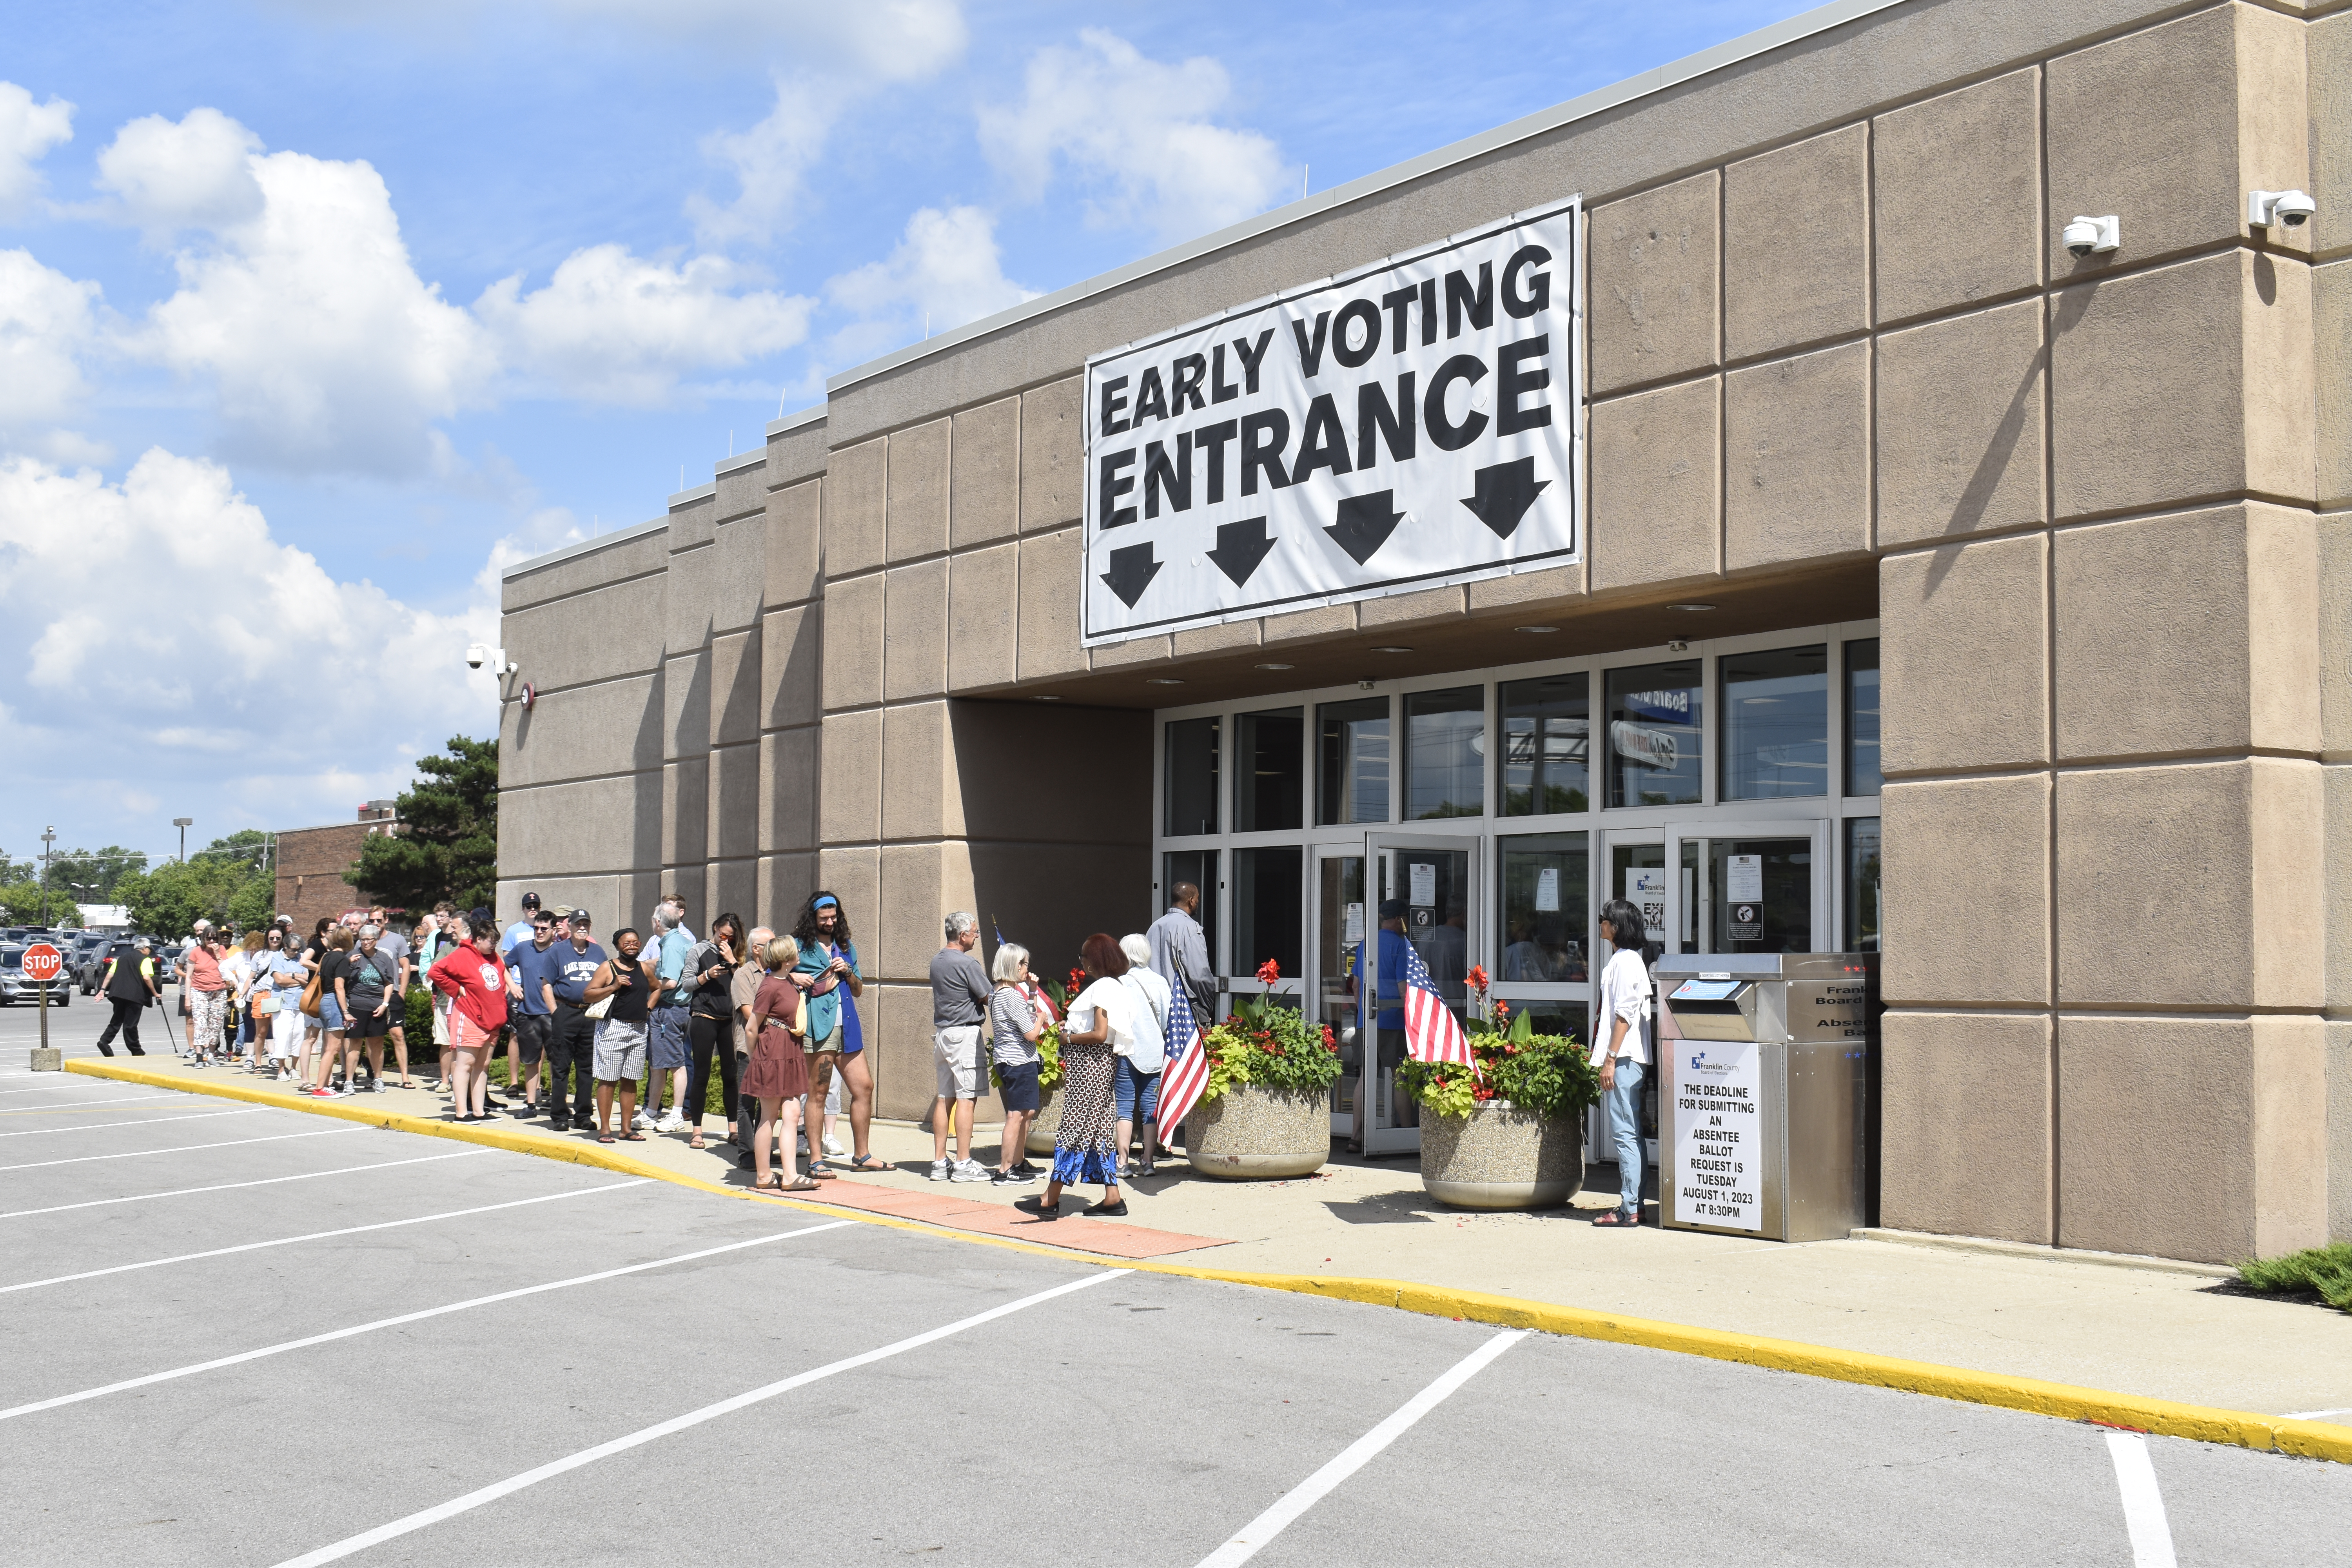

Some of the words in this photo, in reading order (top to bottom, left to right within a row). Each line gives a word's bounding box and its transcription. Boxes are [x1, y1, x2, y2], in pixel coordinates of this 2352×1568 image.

[1101, 327, 1275, 437] EARLY
[1291, 244, 1553, 379] VOTING
[1100, 333, 1552, 531] ENTRANCE
[1644, 903, 1664, 915] EXI
[25, 955, 60, 970] STOP
[564, 961, 578, 975] LAKE
[1844, 1028, 1880, 1036] Ball
[1723, 1063, 1740, 1073] County
[1684, 1083, 1701, 1095] THE
[1704, 1085, 1748, 1098] DEADLINE
[1679, 1098, 1696, 1110] FOR
[1698, 1099, 1754, 1114] SUBMITTING
[1709, 1115, 1722, 1126] AN
[1693, 1129, 1740, 1143] ABSENTEE
[1699, 1144, 1733, 1157] BALLOT
[1690, 1158, 1731, 1172] REQUEST
[1734, 1162, 1743, 1173] IS
[1696, 1173, 1737, 1188] TUESDAY
[1682, 1187, 1719, 1201] AUGUST
[1721, 1191, 1729, 1204] 1,
[1731, 1192, 1753, 1204] 2023
[1695, 1203, 1706, 1214] AT
[1709, 1204, 1740, 1218] 8:30PM
